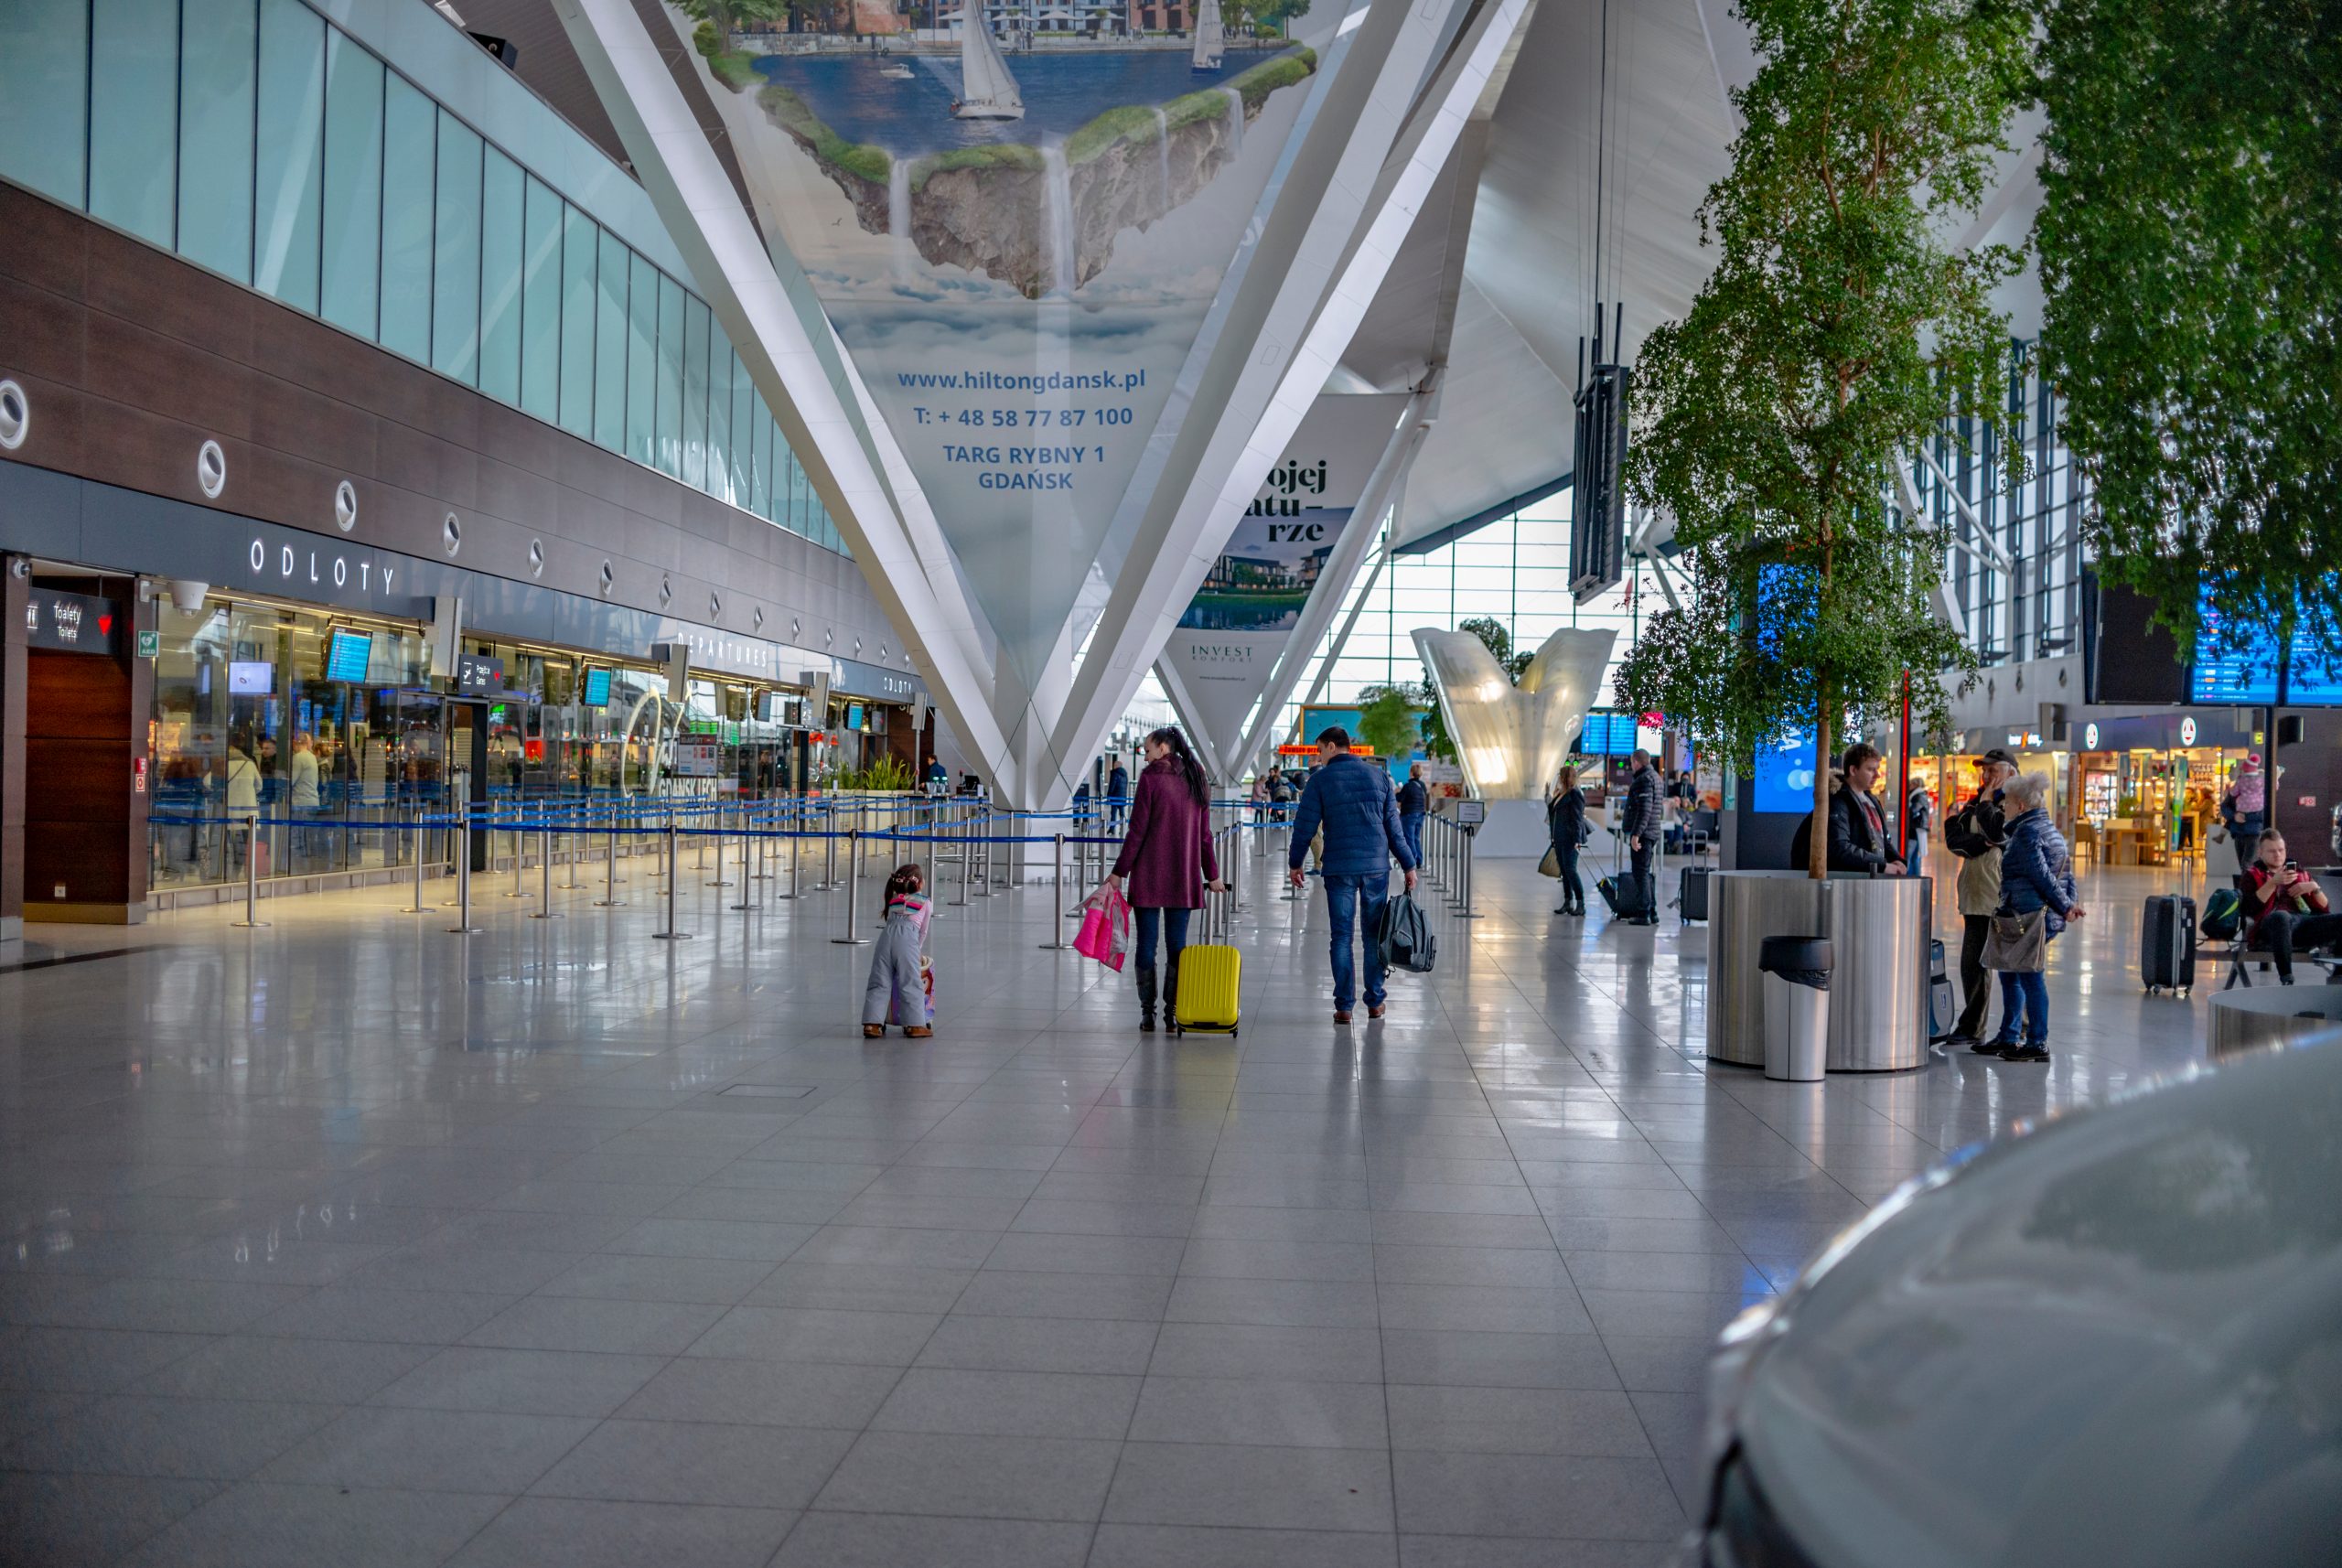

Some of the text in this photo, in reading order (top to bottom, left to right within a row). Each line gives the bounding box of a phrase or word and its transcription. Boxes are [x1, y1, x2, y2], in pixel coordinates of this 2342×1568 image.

[897, 369, 1144, 394] www.hiltongdansk.pl
[913, 407, 931, 424] T:
[959, 409, 984, 426] 48
[993, 410, 1018, 426] 58
[1025, 410, 1051, 426] 77
[1059, 409, 1086, 426] 87
[1094, 407, 1133, 425] 100
[942, 446, 1104, 464] TARG RYBNY 1
[979, 468, 1073, 489] GDAŃSK
[1266, 460, 1327, 494] ojej
[1268, 523, 1325, 542] rze
[251, 541, 393, 595] ODLOTY
[53, 605, 81, 624] Toalety
[57, 626, 78, 638] Toilets
[678, 632, 766, 667] DEPARTURES
[1192, 645, 1252, 657] INVEST
[884, 677, 912, 694] ODLOTY
